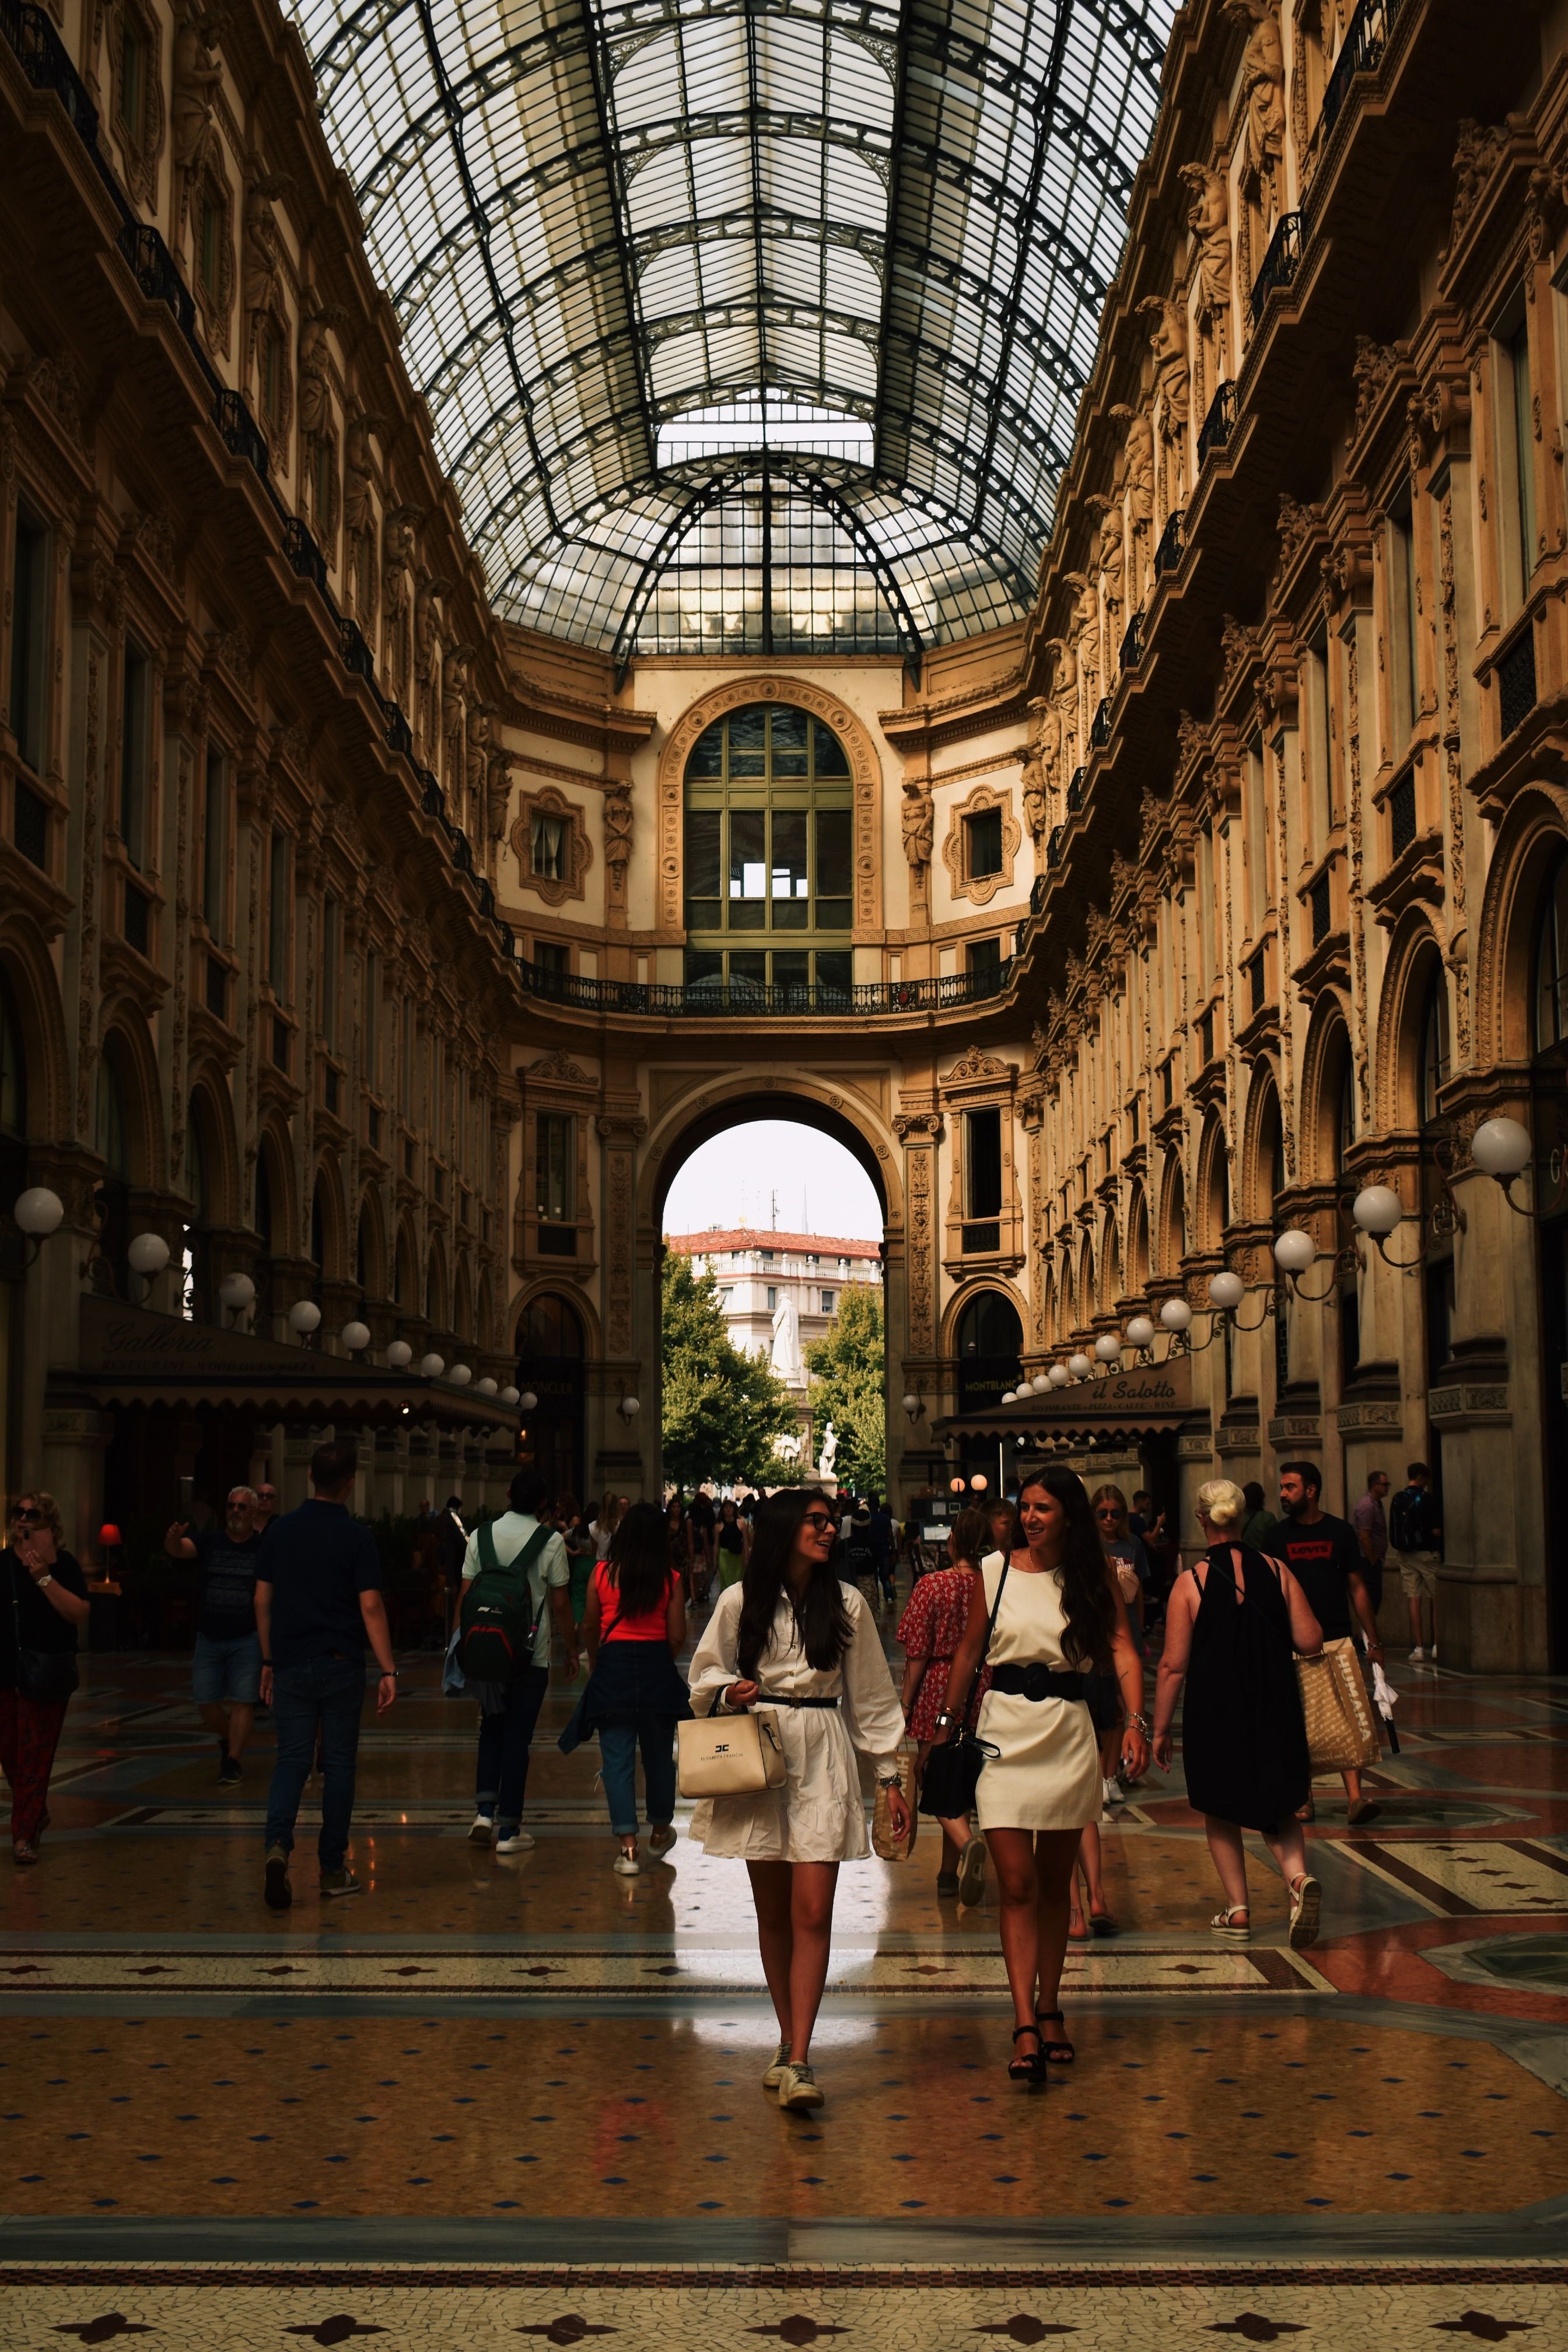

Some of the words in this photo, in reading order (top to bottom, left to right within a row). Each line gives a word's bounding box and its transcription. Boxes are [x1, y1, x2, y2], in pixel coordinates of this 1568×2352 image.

[102, 1321, 214, 1353] Galleria
[520, 1381, 574, 1396] MONCLER
[964, 1379, 1017, 1392] MONTBLANC
[1091, 1380, 1108, 1399] il
[1112, 1380, 1176, 1399] Salotto
[1031, 1403, 1083, 1412] RISTORANTE
[1154, 1401, 1177, 1409] WINE
[1335, 1653, 1371, 1742] HUMANA
